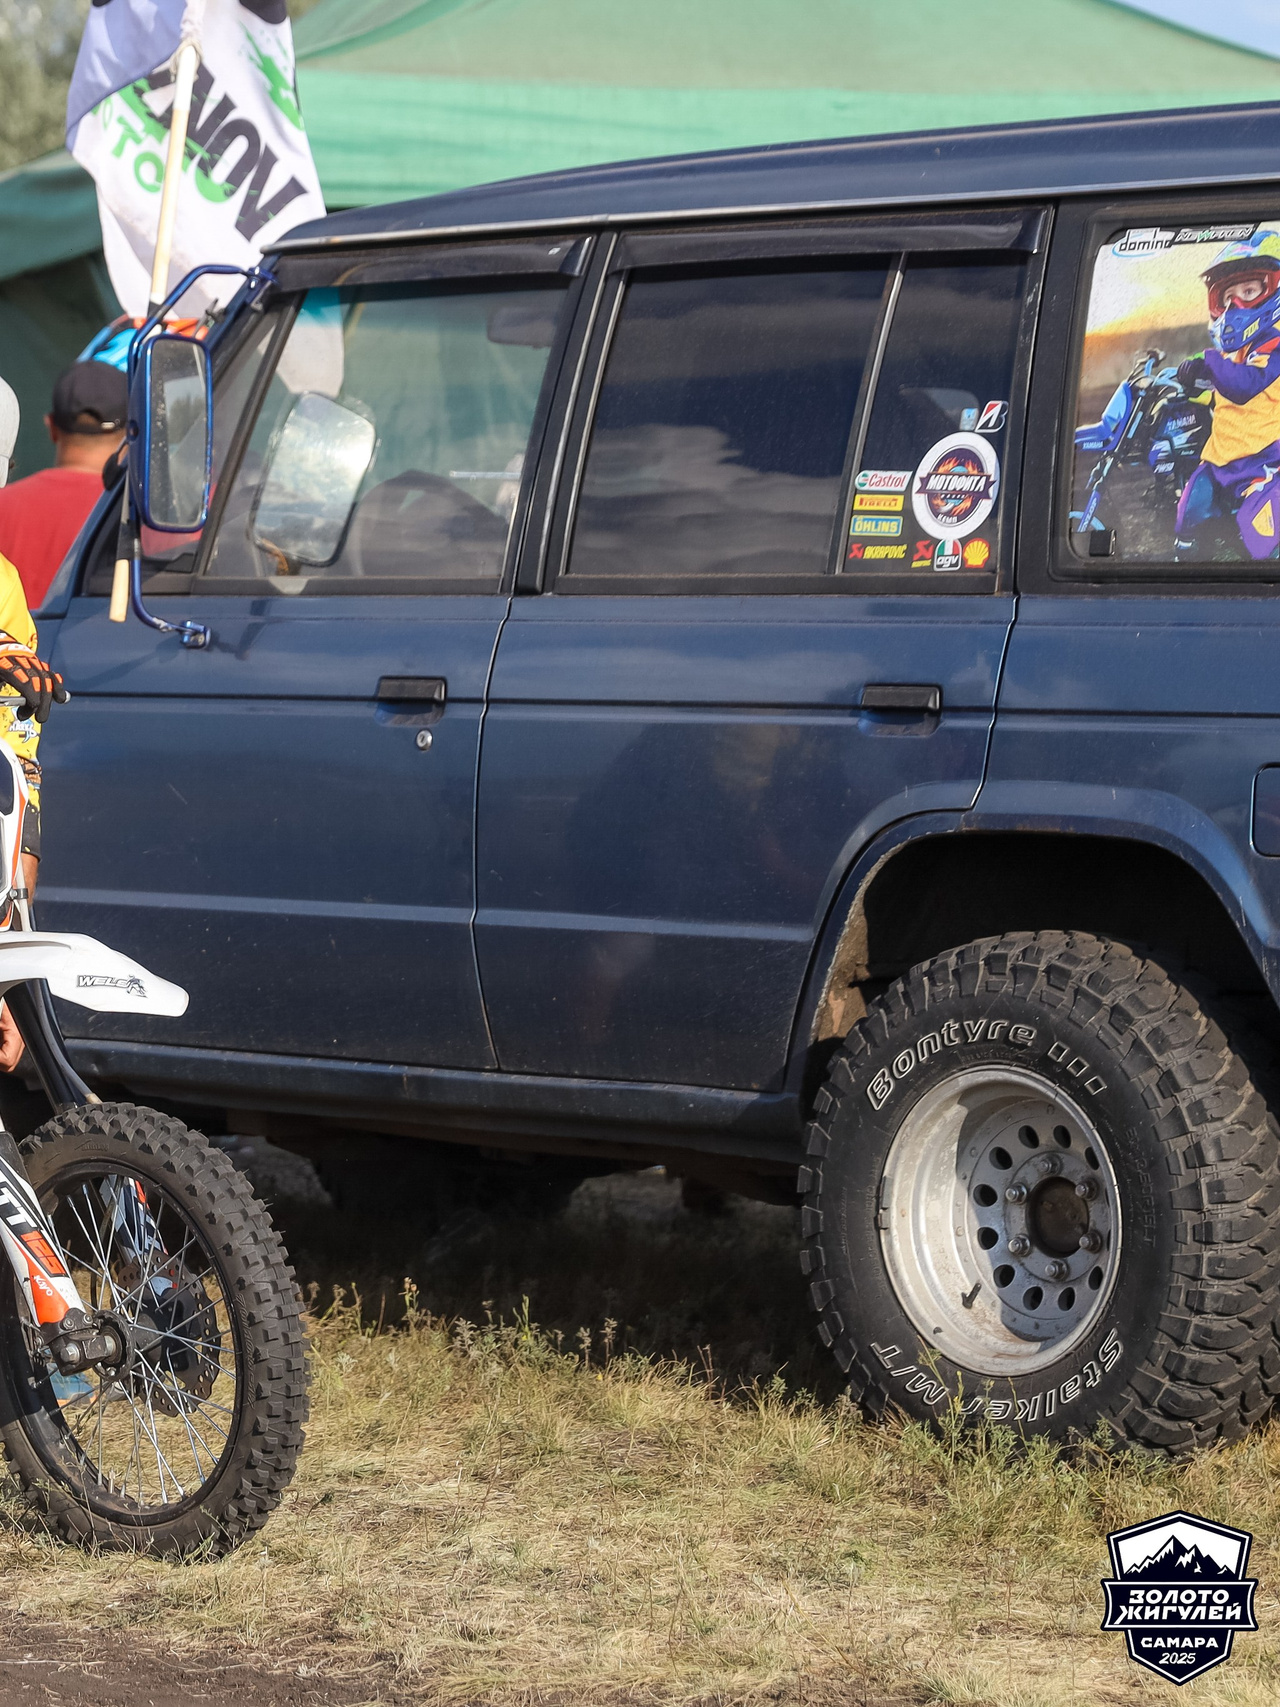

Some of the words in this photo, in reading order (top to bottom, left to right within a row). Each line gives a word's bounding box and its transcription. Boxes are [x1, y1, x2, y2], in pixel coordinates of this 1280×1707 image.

[868, 473, 907, 488] Castrol
[936, 556, 959, 568] agv
[866, 1018, 1037, 1110] Bontyre
[34, 1275, 53, 1297] KAYO
[870, 1341, 949, 1406] M/T
[960, 1328, 1124, 1422] Stalker
